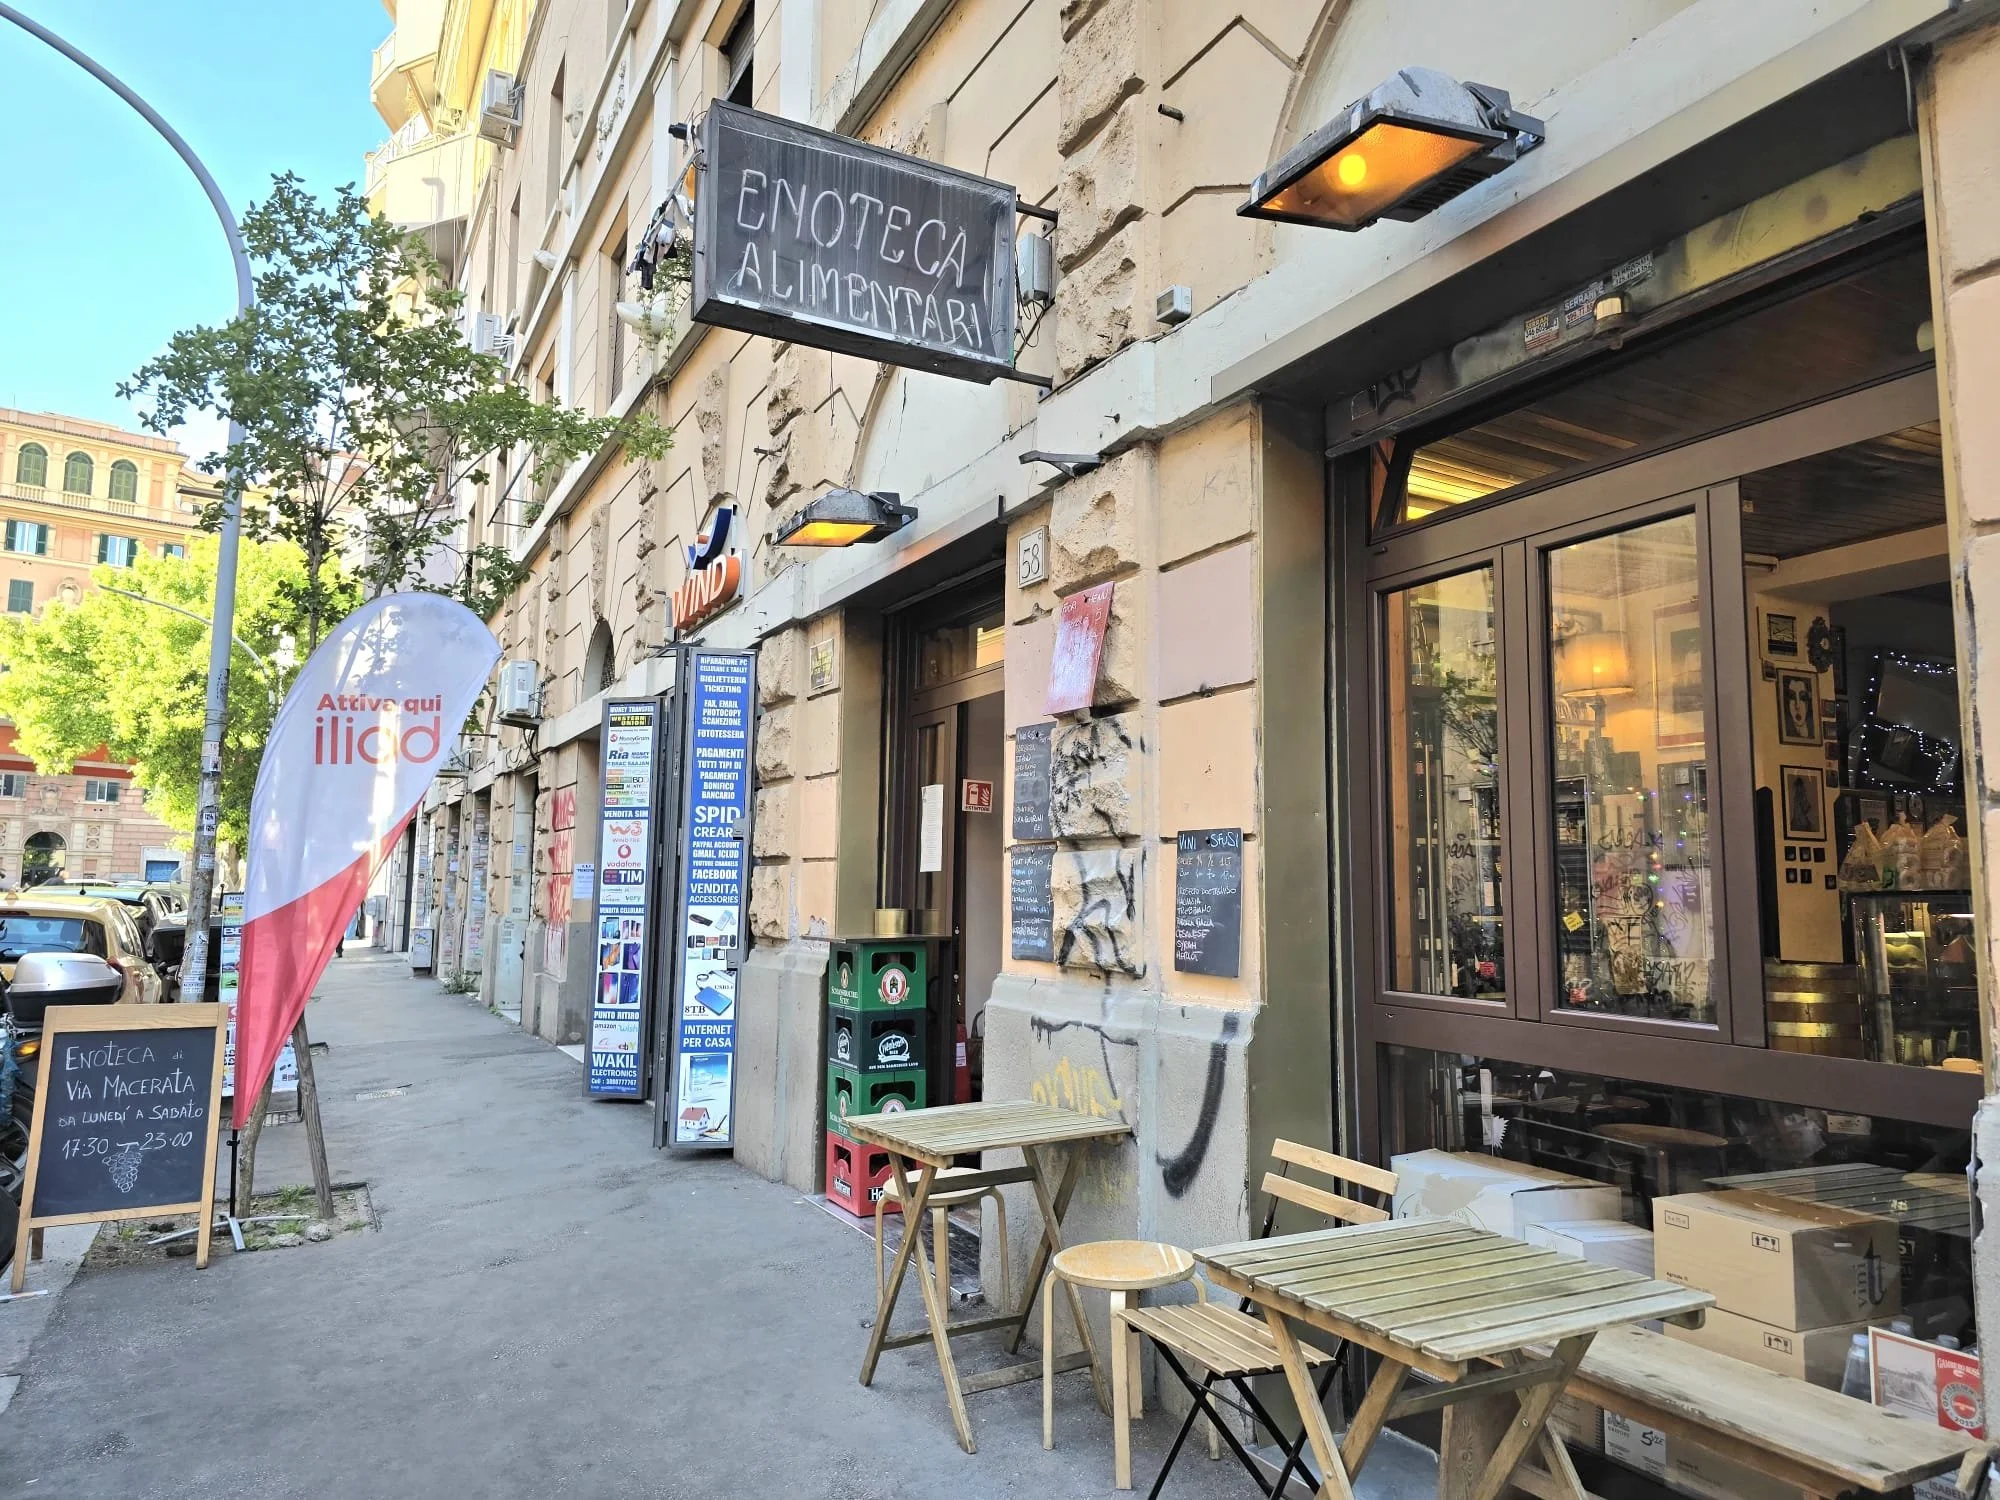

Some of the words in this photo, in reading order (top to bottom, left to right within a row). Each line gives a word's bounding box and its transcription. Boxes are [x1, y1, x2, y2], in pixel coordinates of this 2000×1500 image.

[737, 169, 967, 288] ENOTECA
[734, 241, 983, 349] ALIMENTARI
[1021, 543, 1040, 579] 58
[672, 554, 740, 630] WIND
[700, 656, 738, 665] RIPARAZIONE
[700, 675, 746, 684] BIGLIETTERIA
[704, 685, 741, 693] TICKETING
[317, 693, 396, 711] Attiva
[404, 694, 441, 715] qui
[719, 700, 738, 709] EMAIL
[703, 708, 741, 717] PHOTOCOPY
[697, 729, 744, 738] FOTOTESSERA
[315, 716, 441, 765] iliad
[608, 748, 629, 759] Ria
[696, 747, 744, 758] PAGAMENTI
[698, 760, 717, 768] TUTTI
[719, 761, 732, 769] TIPI
[700, 772, 738, 780] PAGAMENTI
[704, 782, 734, 790] BONIFICO
[702, 791, 735, 799] BANCARIO
[604, 810, 633, 818] VENDITA
[695, 805, 740, 823] SPID
[1179, 834, 1197, 850] VINI
[1210, 831, 1239, 849] SFUSI
[607, 860, 641, 868] vodafone
[619, 870, 642, 883] TIM
[692, 869, 738, 879] FACEBOOK
[690, 883, 738, 894] VENDITA
[689, 895, 739, 903] ACCESSORIES
[684, 1005, 706, 1014] 8TB
[594, 1010, 616, 1019] PUNTO
[617, 1011, 639, 1020] RITIRO
[684, 1024, 732, 1035] INTERNET
[683, 1037, 702, 1047] PER
[705, 1038, 732, 1047] CASA
[65, 1040, 155, 1070] ENOTECA
[172, 1050, 184, 1060] di
[592, 1053, 637, 1068] WAKIL
[591, 1069, 637, 1077] ELECTRONICS
[103, 1068, 195, 1100] MACERATA
[58, 1116, 76, 1127] DA
[136, 1109, 144, 1120] A
[149, 1099, 203, 1120] SABATO
[1936, 1358, 1966, 1371] GAMBERO
